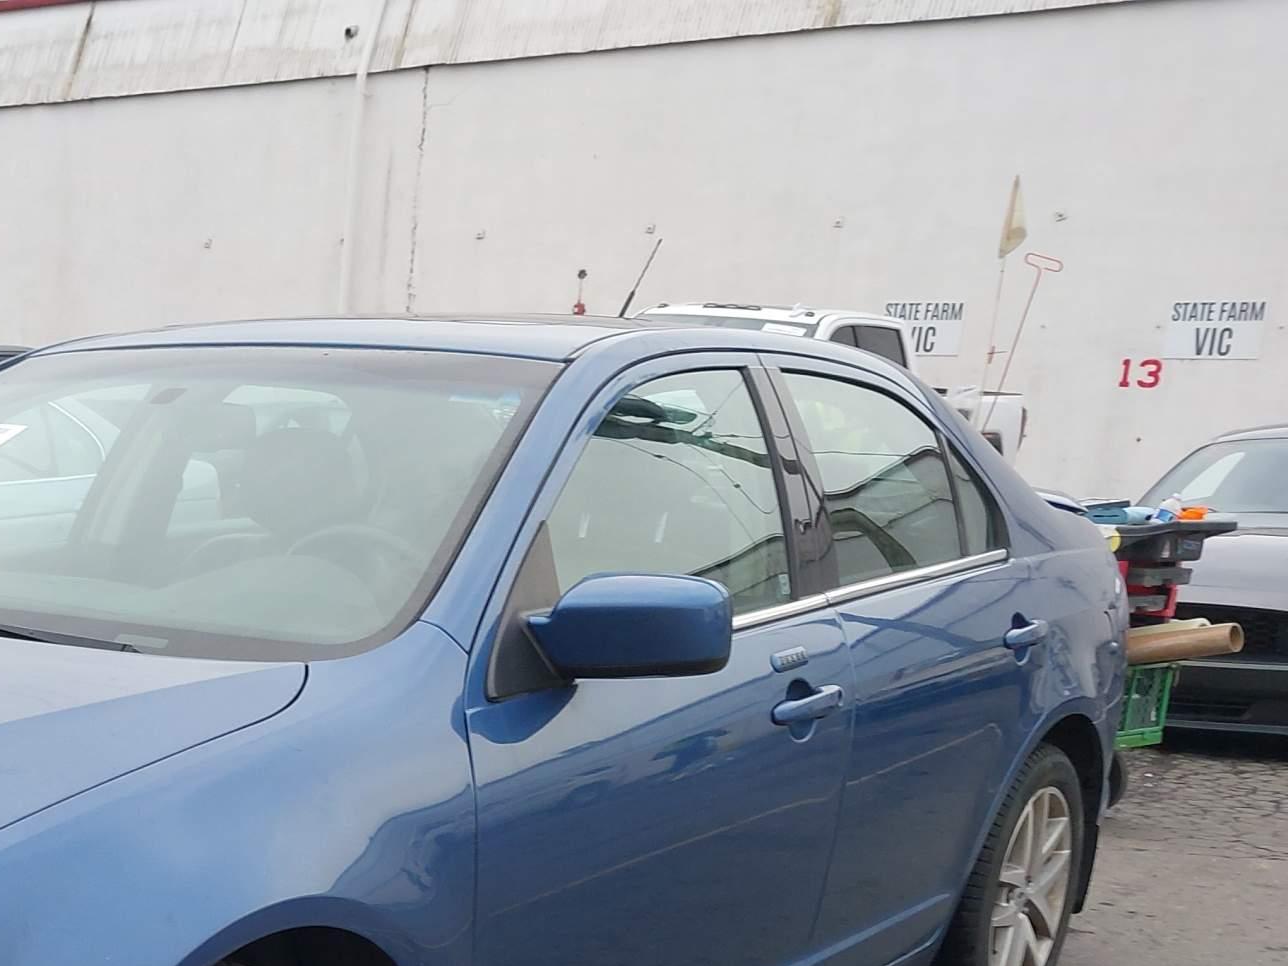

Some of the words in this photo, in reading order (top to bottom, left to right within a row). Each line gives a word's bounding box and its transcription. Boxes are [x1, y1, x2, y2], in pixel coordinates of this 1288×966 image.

[884, 302, 922, 320] STATE
[924, 302, 964, 320] FARM
[1171, 302, 1216, 322] STATE
[1218, 301, 1267, 321] FARM
[1194, 327, 1233, 357] VIC
[1119, 358, 1162, 388] 13
